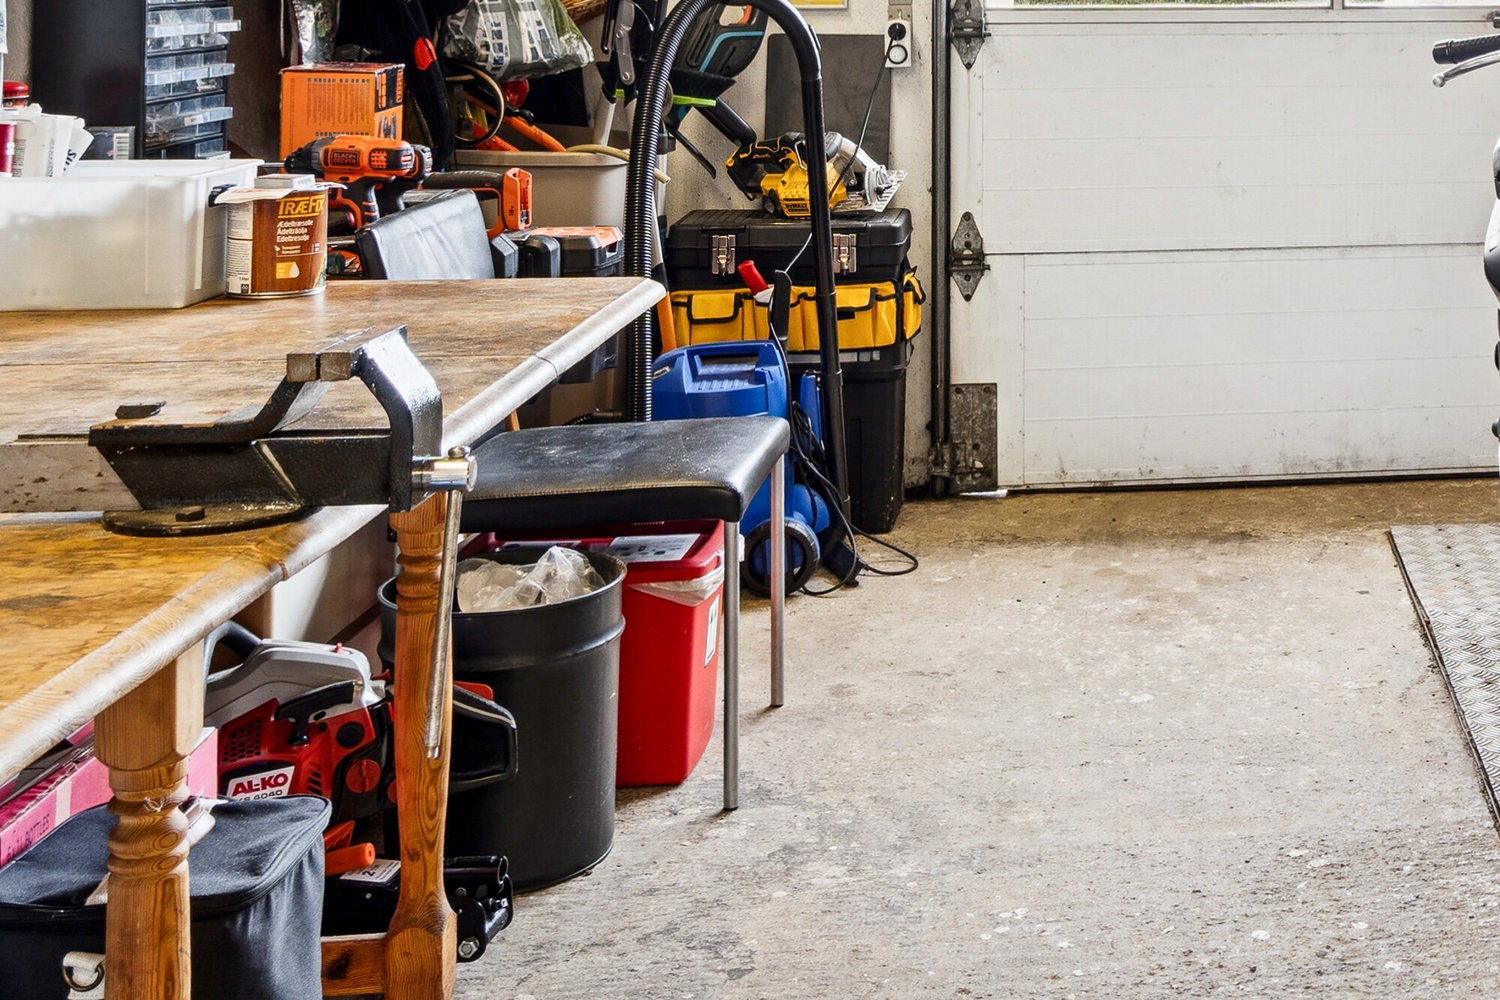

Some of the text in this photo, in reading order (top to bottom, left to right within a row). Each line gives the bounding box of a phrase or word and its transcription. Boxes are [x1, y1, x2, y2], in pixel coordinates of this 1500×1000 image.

[278, 196, 325, 216] TRÆFIX
[231, 773, 289, 797] AL-KO
[253, 789, 283, 800] 4040
